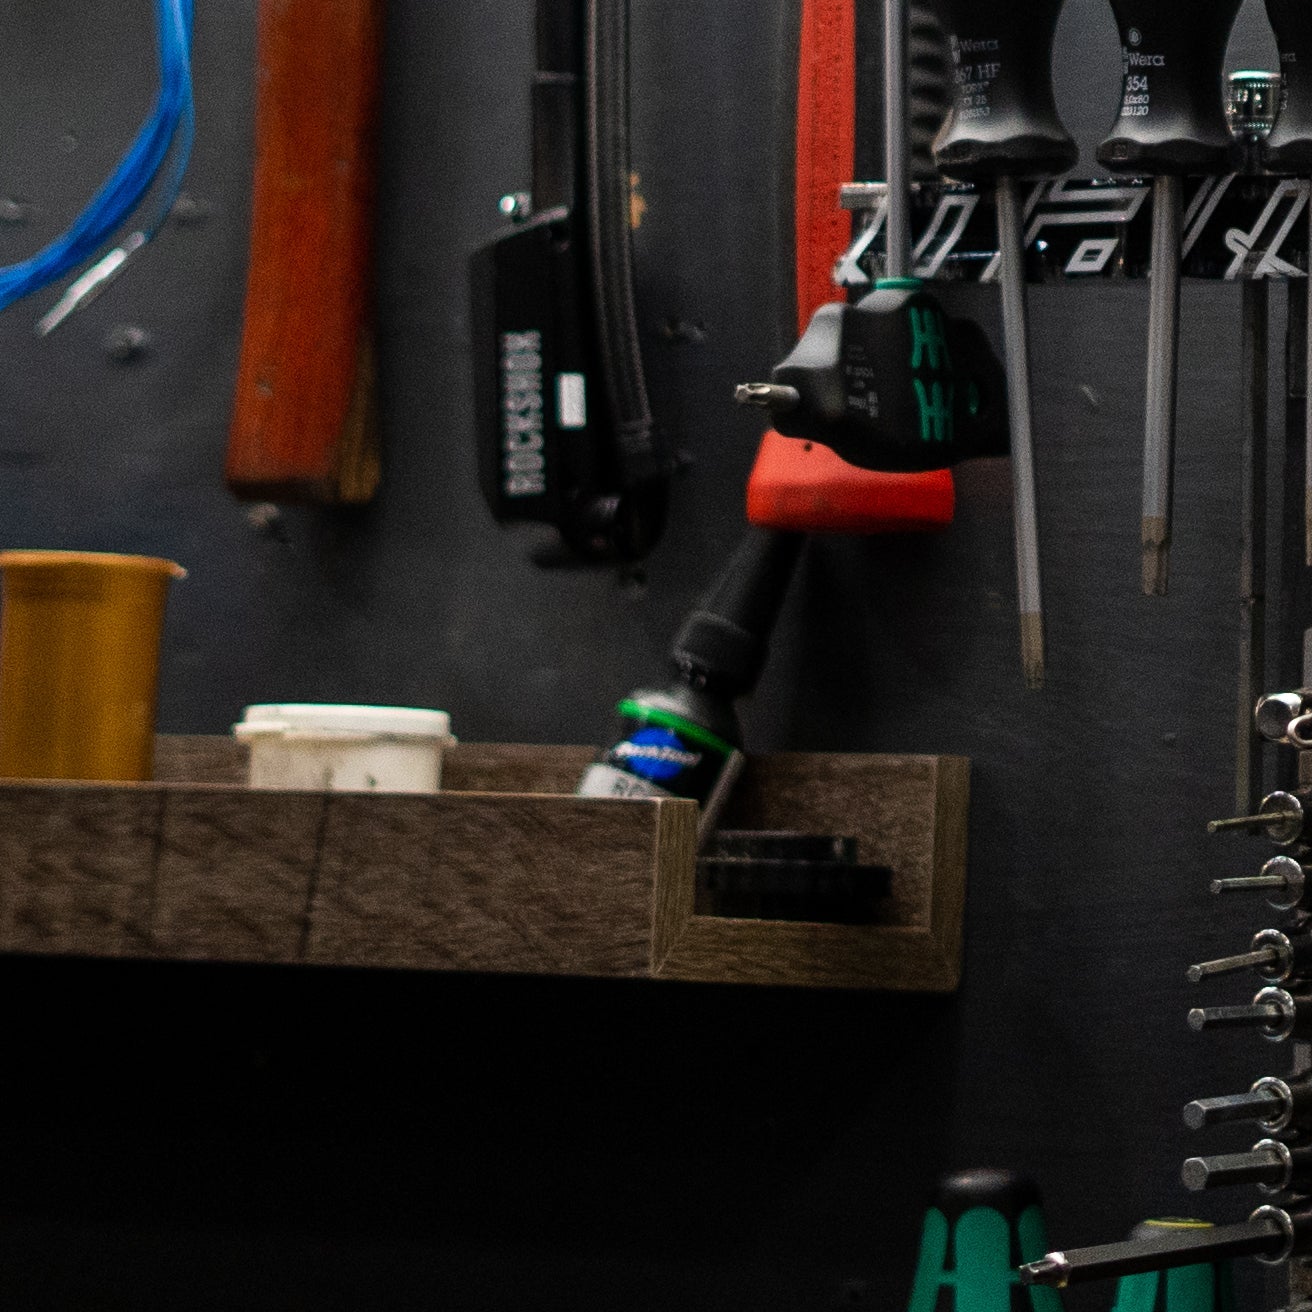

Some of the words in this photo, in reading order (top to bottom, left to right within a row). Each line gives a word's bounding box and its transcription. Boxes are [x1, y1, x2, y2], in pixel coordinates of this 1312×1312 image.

[960, 38, 999, 53] Wera
[1128, 51, 1166, 66] Wera
[977, 62, 1001, 79] HF
[1126, 75, 1149, 91] 354
[503, 329, 546, 497] ROCKSHOX
